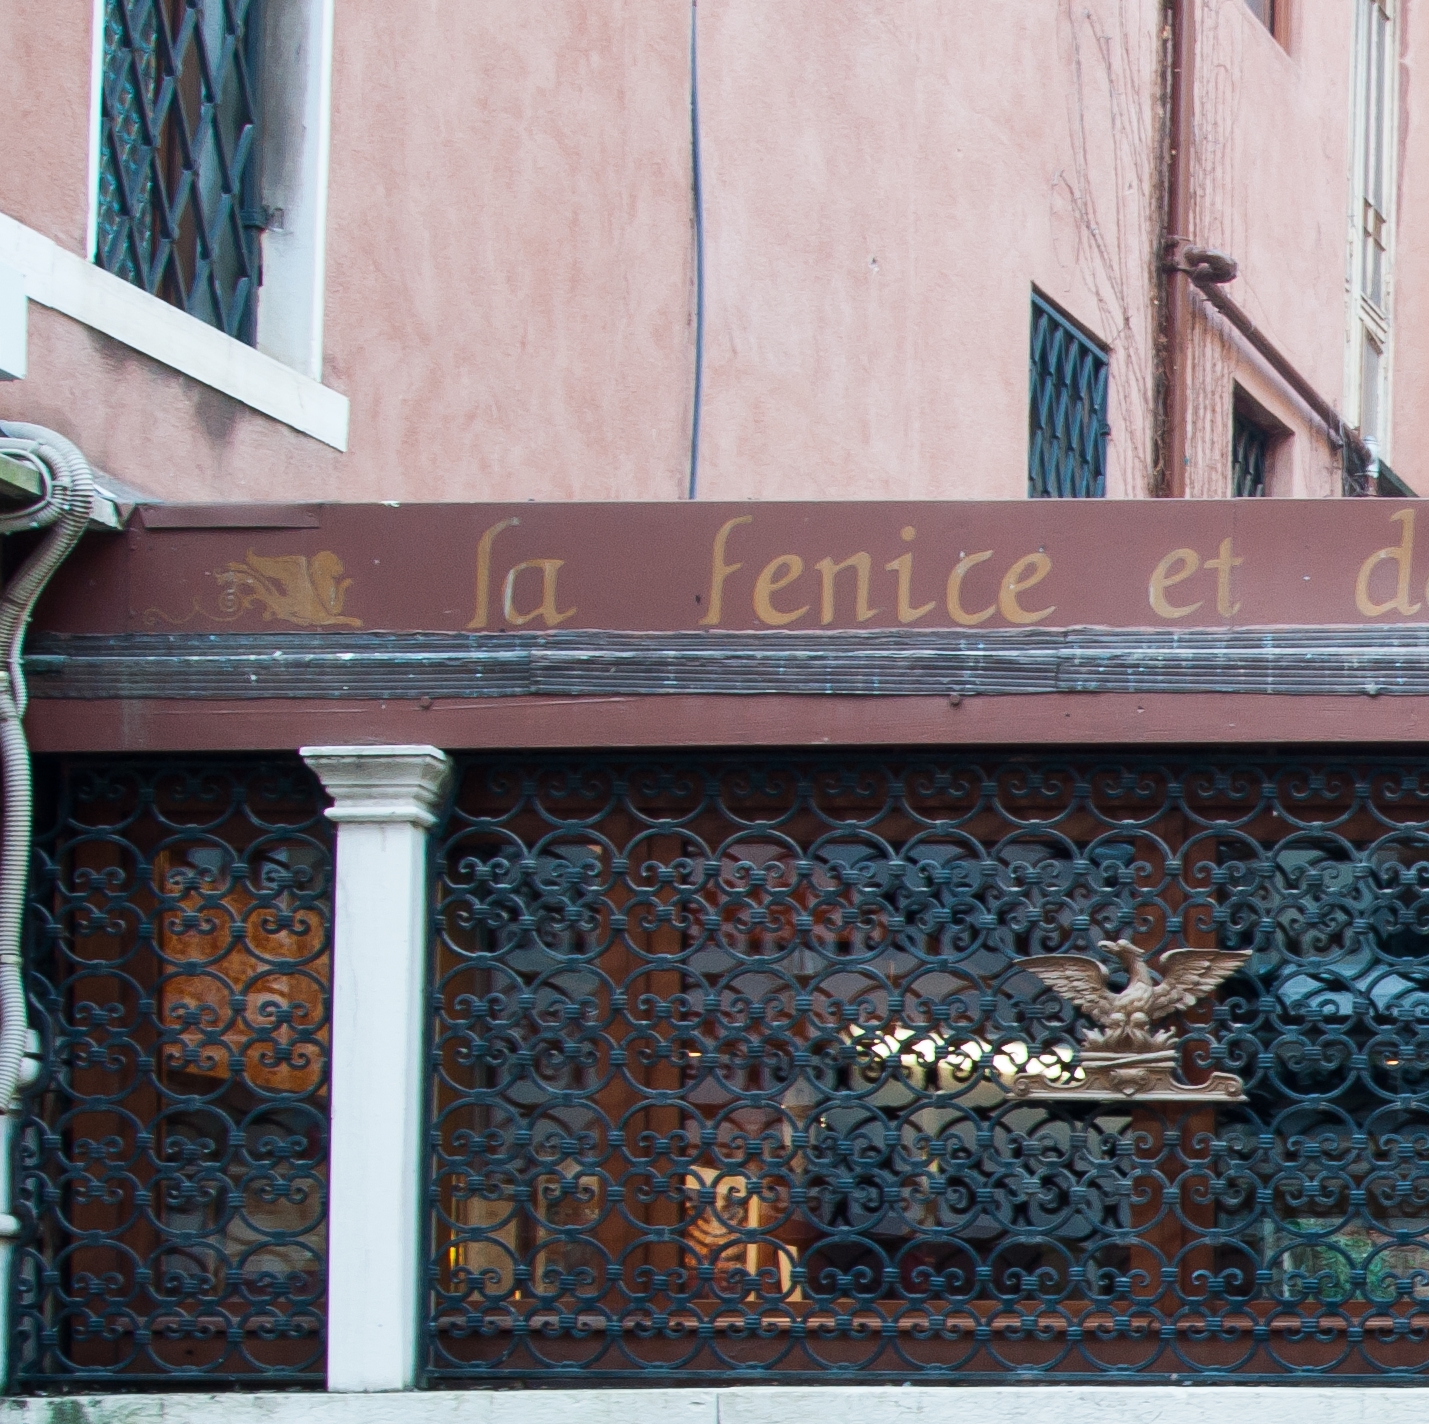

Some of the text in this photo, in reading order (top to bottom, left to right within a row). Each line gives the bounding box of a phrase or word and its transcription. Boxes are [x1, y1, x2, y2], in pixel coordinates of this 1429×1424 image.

[466, 516, 577, 629] la
[697, 514, 1060, 628] fenice
[1148, 536, 1242, 620] et
